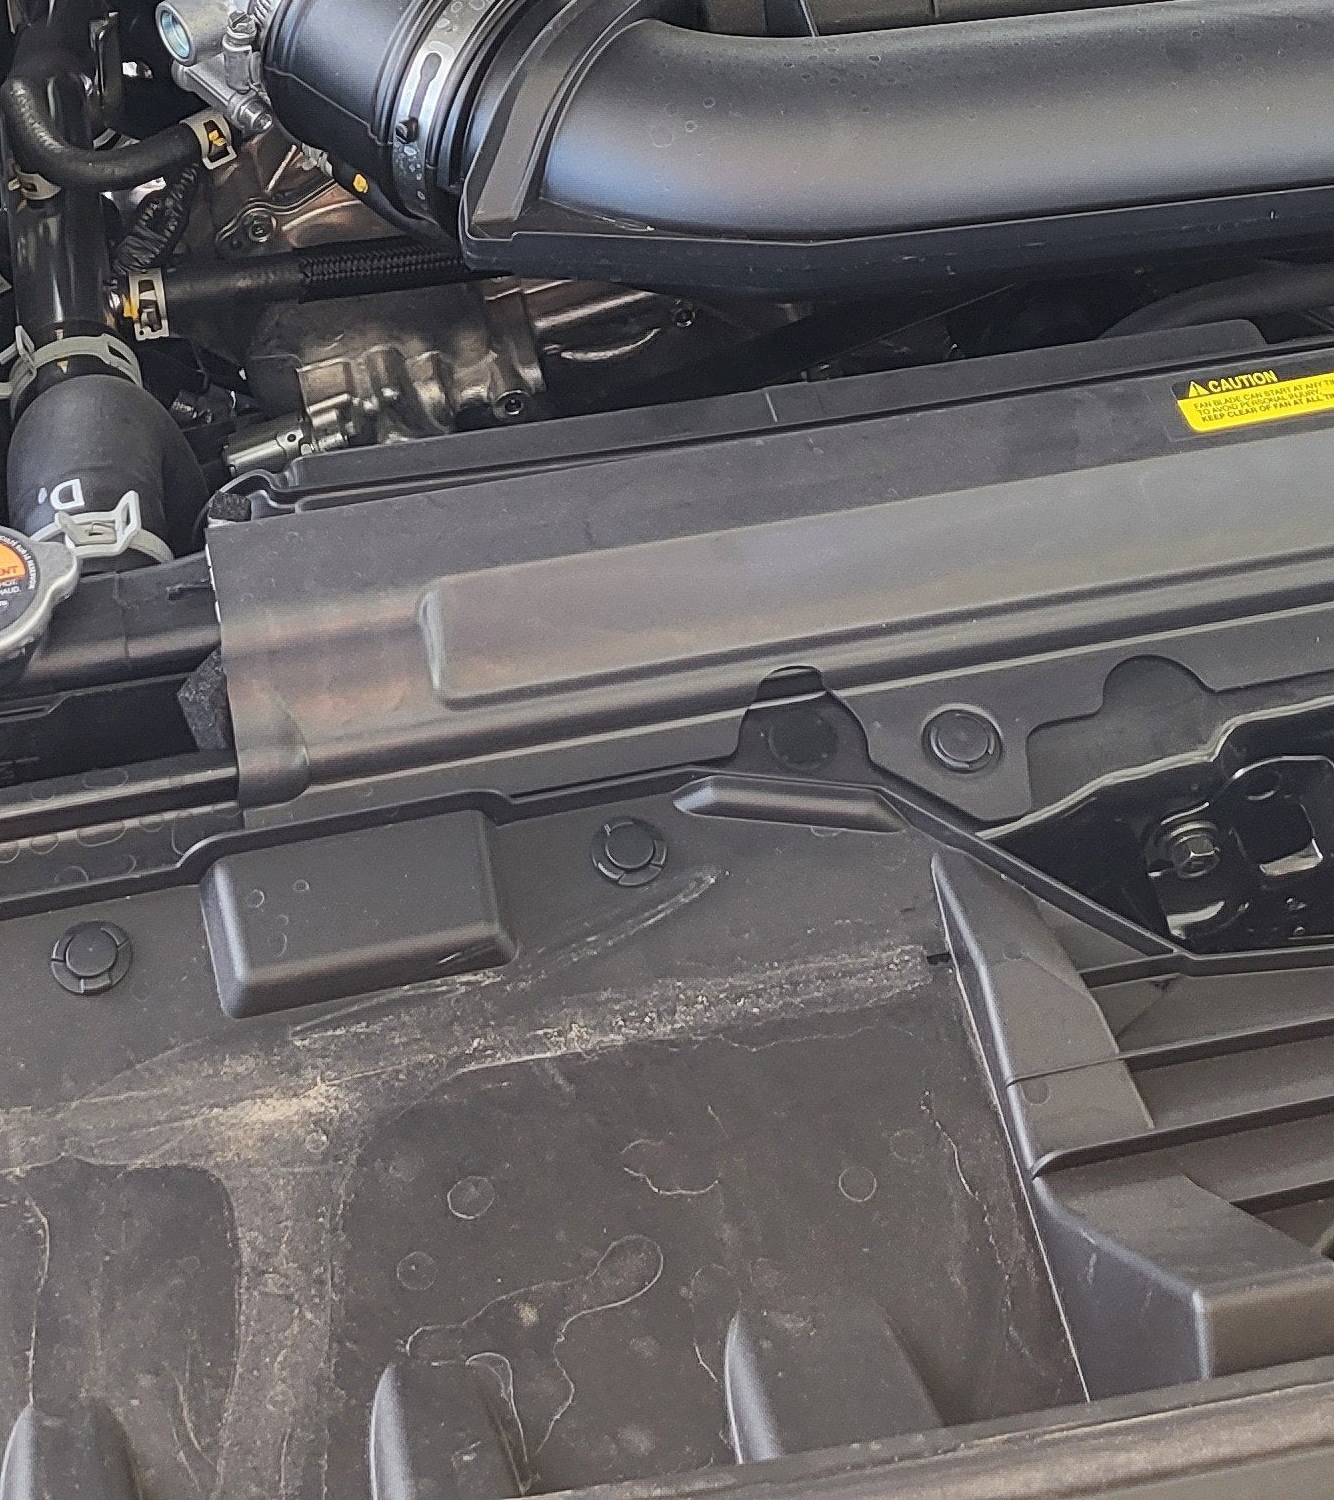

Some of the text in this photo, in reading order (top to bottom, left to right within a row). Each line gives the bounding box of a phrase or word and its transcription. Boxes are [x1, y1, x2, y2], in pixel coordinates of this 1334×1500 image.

[1193, 401, 1213, 410] FAN
[1213, 395, 1241, 407] BLADE
[1243, 391, 1263, 401] CAN
[1264, 386, 1293, 398] START
[1305, 380, 1323, 391] ANY
[1208, 369, 1280, 394] CAUTION
[1201, 412, 1225, 423] KEEP
[1226, 408, 1258, 419] CLEAR
[1259, 404, 1272, 413] OF
[1273, 400, 1292, 410] FAN
[1293, 397, 1305, 406] AT
[1306, 394, 1324, 404] ALL
[1211, 403, 1239, 414] AVOID
[1239, 396, 1287, 410] PERSONAL
